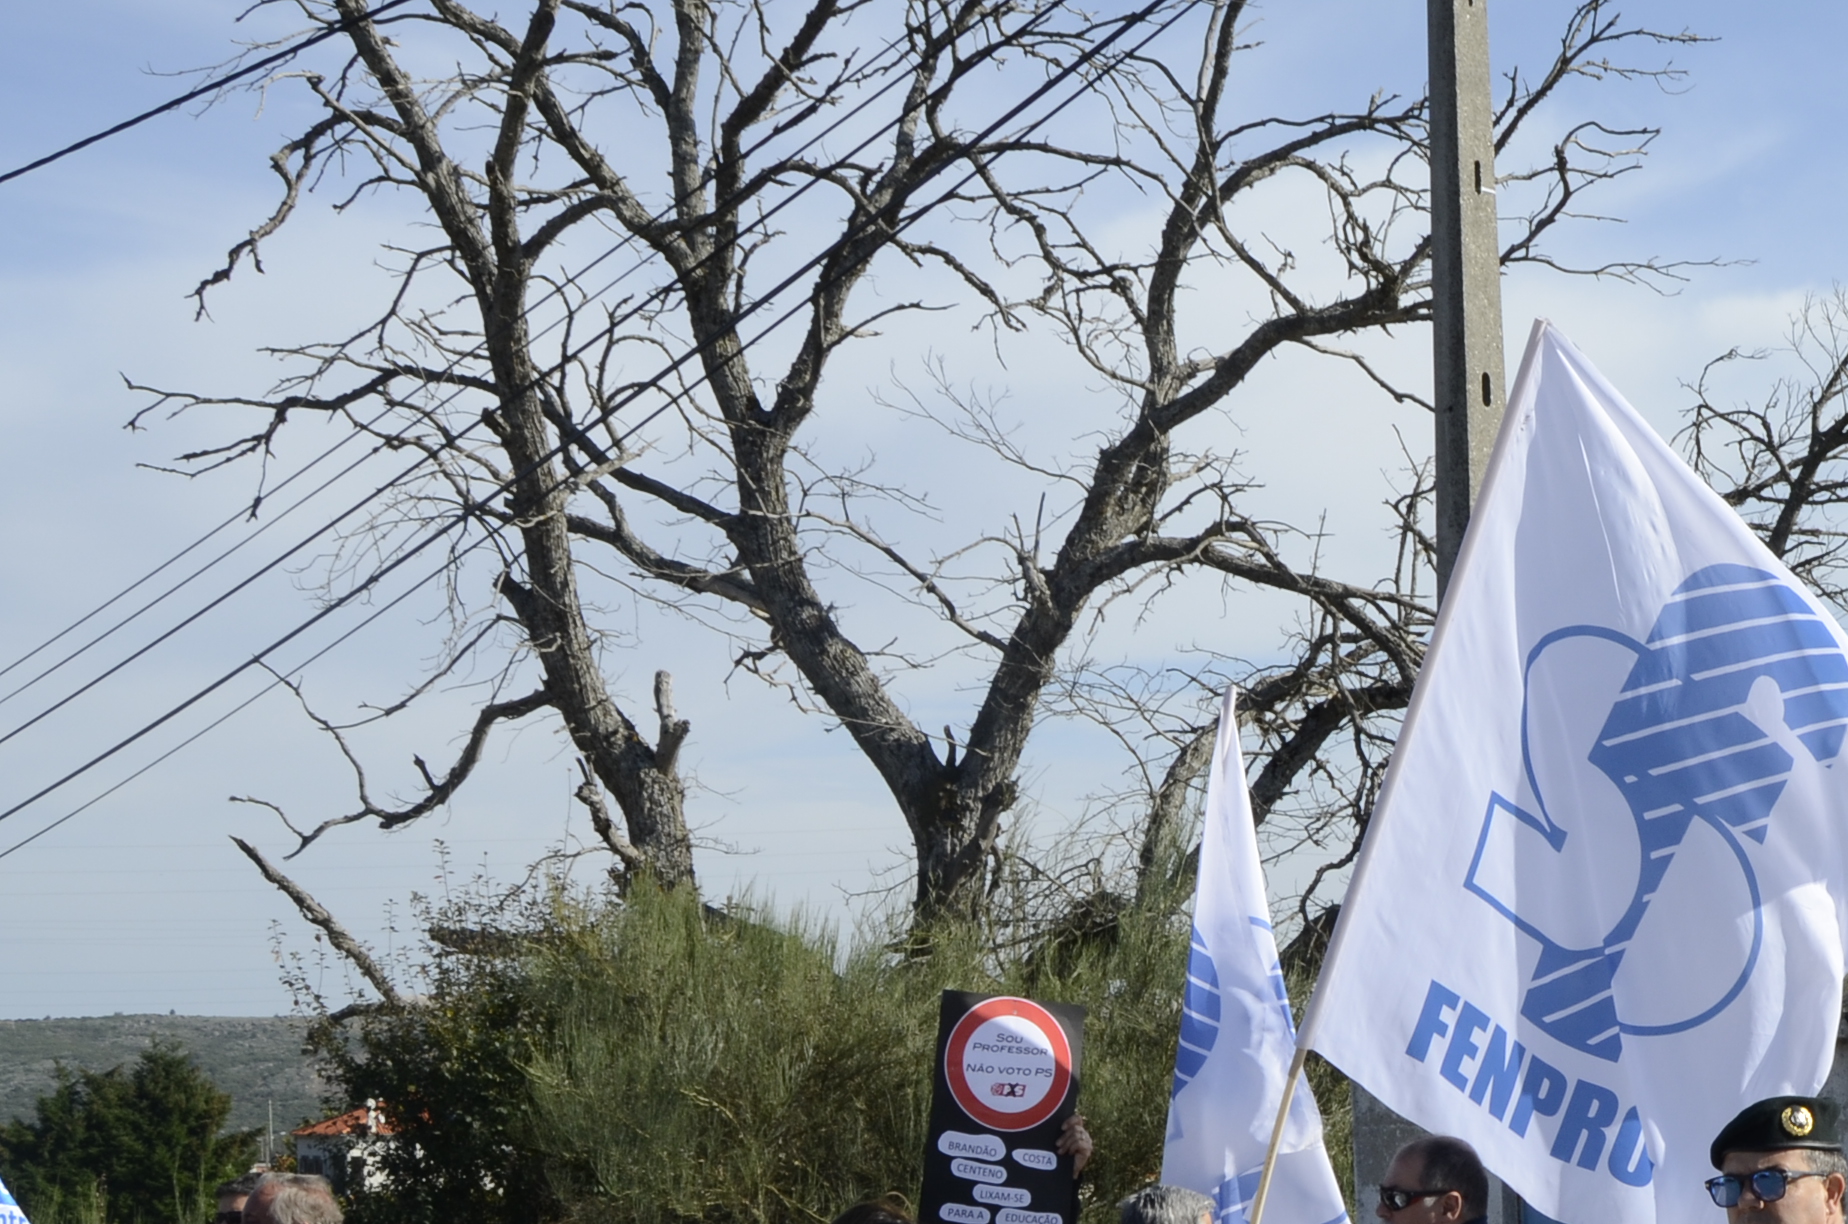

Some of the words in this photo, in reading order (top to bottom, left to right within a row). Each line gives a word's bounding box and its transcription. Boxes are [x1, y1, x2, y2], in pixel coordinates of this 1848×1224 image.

[972, 1042, 1049, 1056] PROFESSOR
[966, 1063, 995, 1074] NÃO
[998, 1067, 1032, 1077] VOTO
[1034, 1068, 1053, 1078] PS
[947, 1140, 998, 1158] BRANDÃO
[1022, 1151, 1053, 1166] COSTA
[956, 1162, 1004, 1179] CENTENO
[979, 1189, 1025, 1204] LIXAM-SE
[947, 1207, 975, 1219] PARA
[975, 1209, 985, 1220] A
